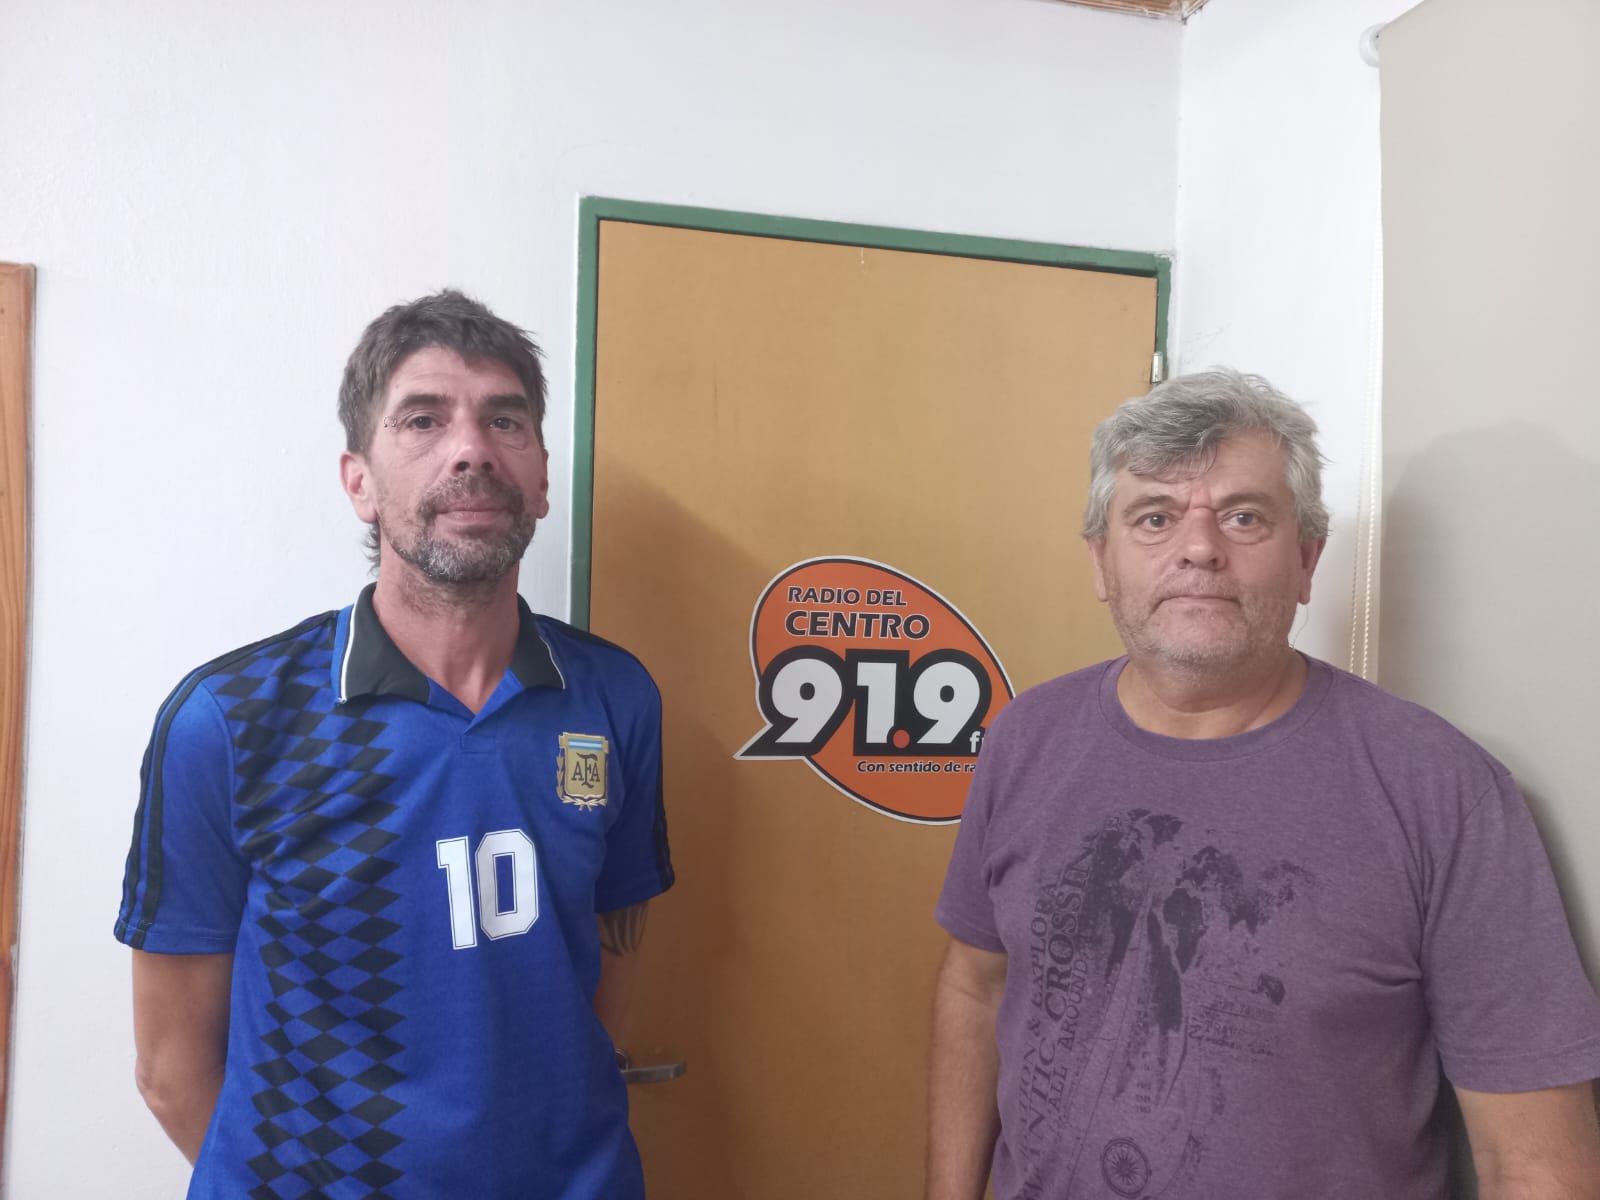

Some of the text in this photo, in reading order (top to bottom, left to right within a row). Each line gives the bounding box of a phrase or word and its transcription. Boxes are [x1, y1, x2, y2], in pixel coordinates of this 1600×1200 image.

[788, 586, 907, 606] RADIO DEL
[785, 611, 930, 639] CENTRO
[760, 653, 983, 751] 91.9
[969, 730, 984, 753] f
[571, 752, 601, 788] AFA
[857, 761, 885, 773] Con
[888, 761, 940, 773] sentido
[944, 761, 960, 773] de
[436, 828, 539, 950] 10
